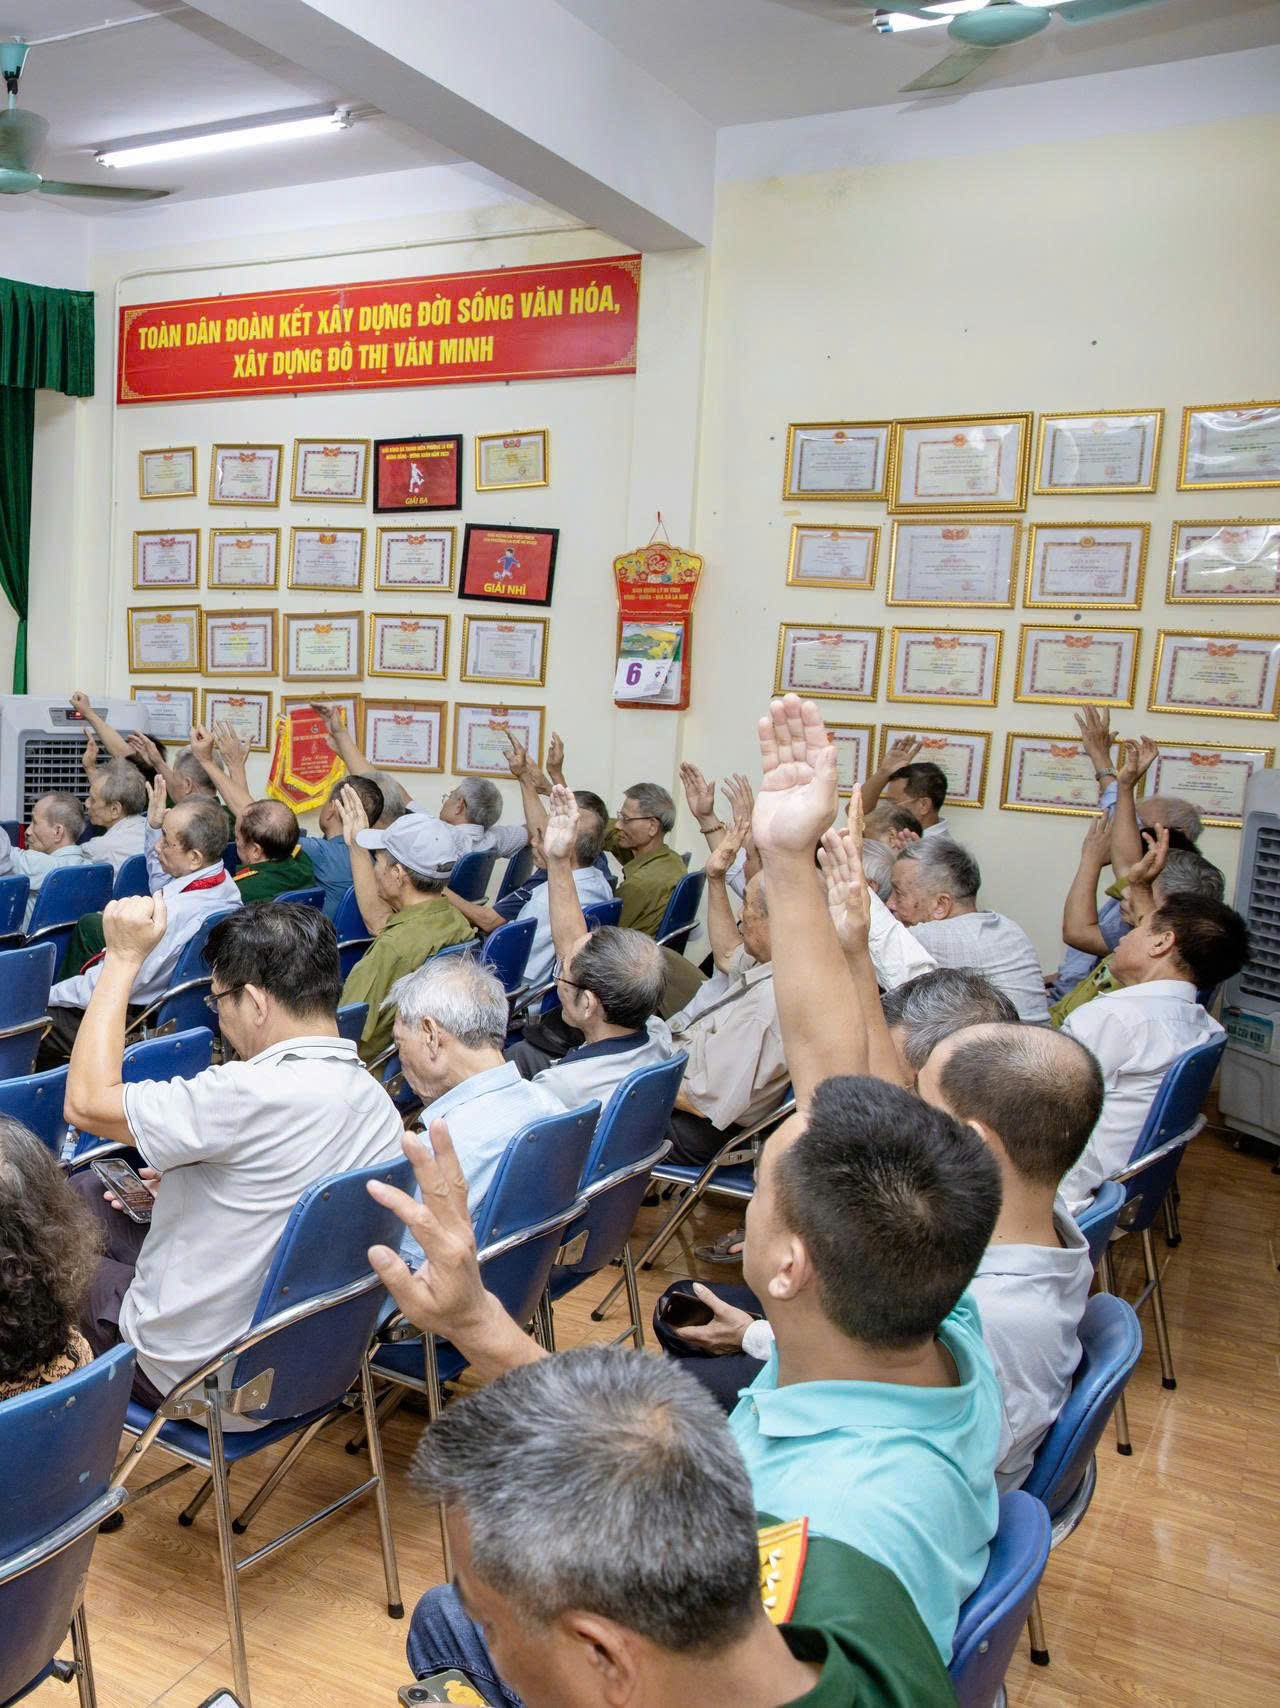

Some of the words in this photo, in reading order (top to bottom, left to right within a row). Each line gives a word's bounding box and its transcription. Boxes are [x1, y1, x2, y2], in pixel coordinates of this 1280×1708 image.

[138, 320, 181, 350] TOÀN
[186, 316, 221, 346] DÂN
[225, 313, 274, 343] ĐOÀN
[278, 308, 313, 338] KẾT
[317, 304, 353, 334] XÂY
[359, 301, 412, 337] DỰNG
[417, 294, 452, 328] ĐỜI
[457, 286, 514, 323] SỐNG
[518, 284, 564, 318] VĂN
[570, 280, 621, 315] HÓA,
[233, 348, 267, 379] XÂY
[272, 345, 323, 380] DỰNG
[327, 341, 353, 372] ĐÔ
[359, 344, 389, 376] THỊ
[393, 336, 433, 369] VĂN
[439, 336, 494, 364] MINH
[483, 582, 505, 594] GIẢI
[626, 662, 642, 686] 6
